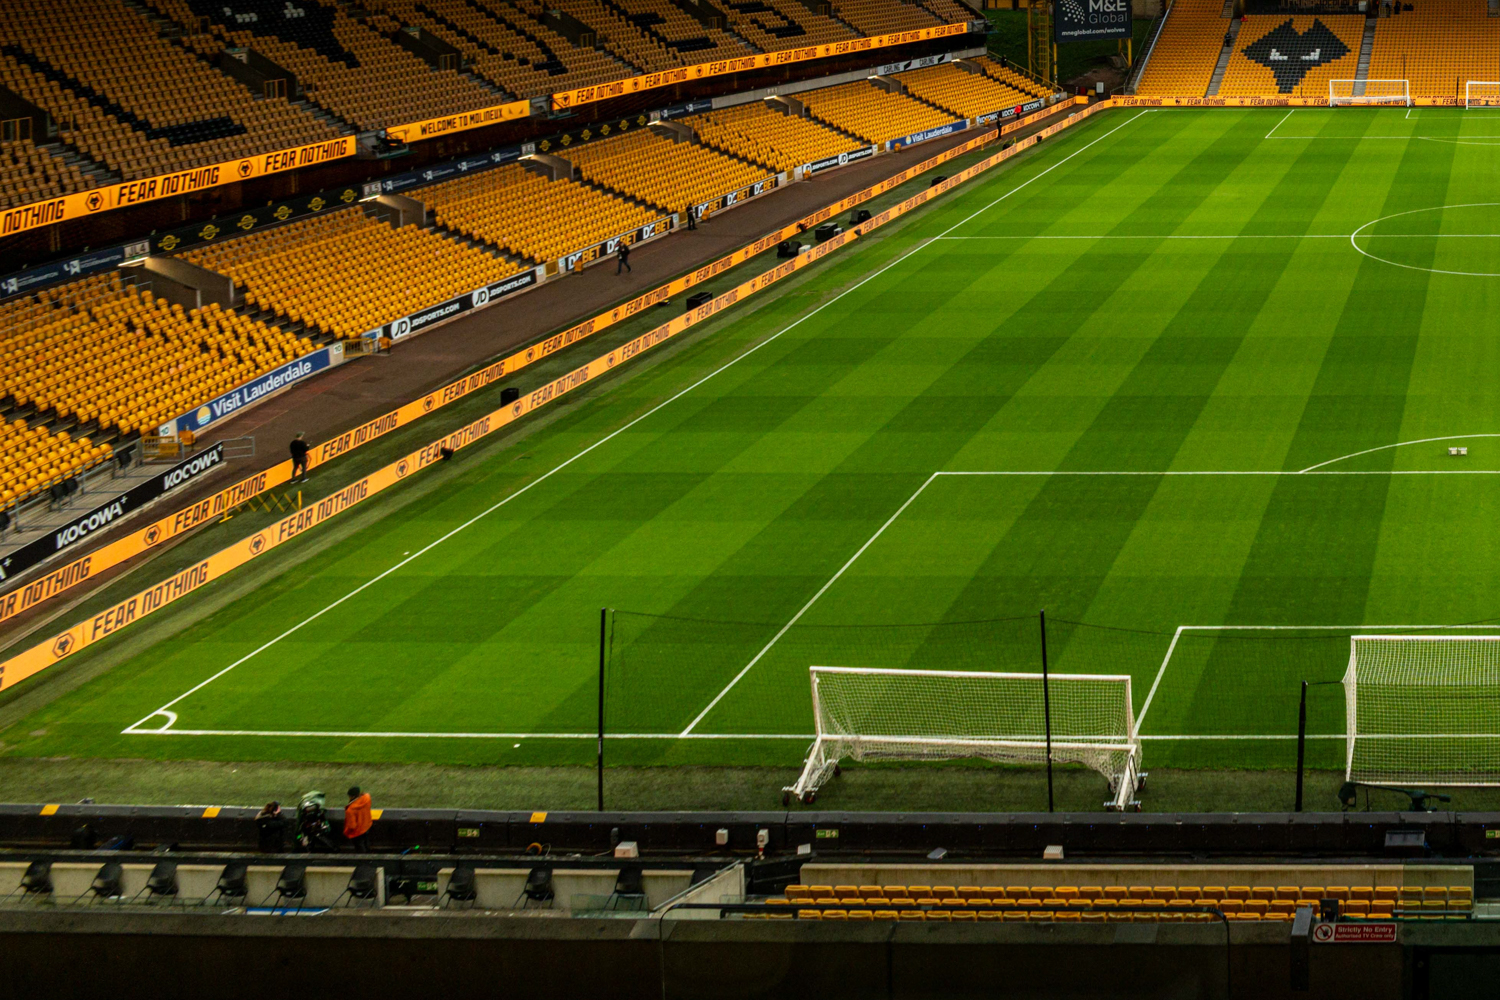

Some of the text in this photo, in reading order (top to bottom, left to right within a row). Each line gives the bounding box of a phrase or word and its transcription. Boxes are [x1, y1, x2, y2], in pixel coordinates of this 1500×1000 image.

[1061, 28, 1125, 37] mneglobal.com/wolves
[1089, 13, 1128, 25] Global
[776, 47, 817, 63] FEAR NOTHING
[836, 39, 871, 53] FEAR NOTHING
[645, 69, 687, 88] FEAR NOTHING
[709, 57, 755, 75] FEAR NOTHING
[577, 82, 624, 102] FEAR NOTHING
[420, 108, 503, 135] WELCOME TO MOLINEUX
[912, 132, 923, 142] Visit
[265, 140, 348, 173] FEAR NOTHING
[117, 167, 220, 205] FEAR NOTHING
[3, 200, 65, 234] NOTHING
[695, 256, 732, 283] FEAR NOTHING
[489, 276, 531, 297] JDSPORTS.COM
[625, 285, 670, 315] FEAR NOTHING
[411, 303, 460, 327] JDSPORTS.COM
[697, 289, 738, 321] FEAR NOTHING
[541, 320, 595, 356] FEAR NOTHING
[622, 324, 670, 361] FEAR NOTHING
[213, 361, 312, 417] Visit Lauderdale
[443, 362, 505, 404] FEAR NOTHING
[530, 366, 589, 406] FEAR NOTHING
[321, 411, 399, 462] FEAR NOTHING
[419, 418, 490, 468] FEAR NOTHING
[174, 473, 267, 533] FEAR NOTHING
[279, 479, 368, 537] FEAR NOTHING
[22, 557, 92, 609] NOTHING
[92, 562, 209, 641] FEAR NOTHING
[1374, 926, 1392, 934] Entry
